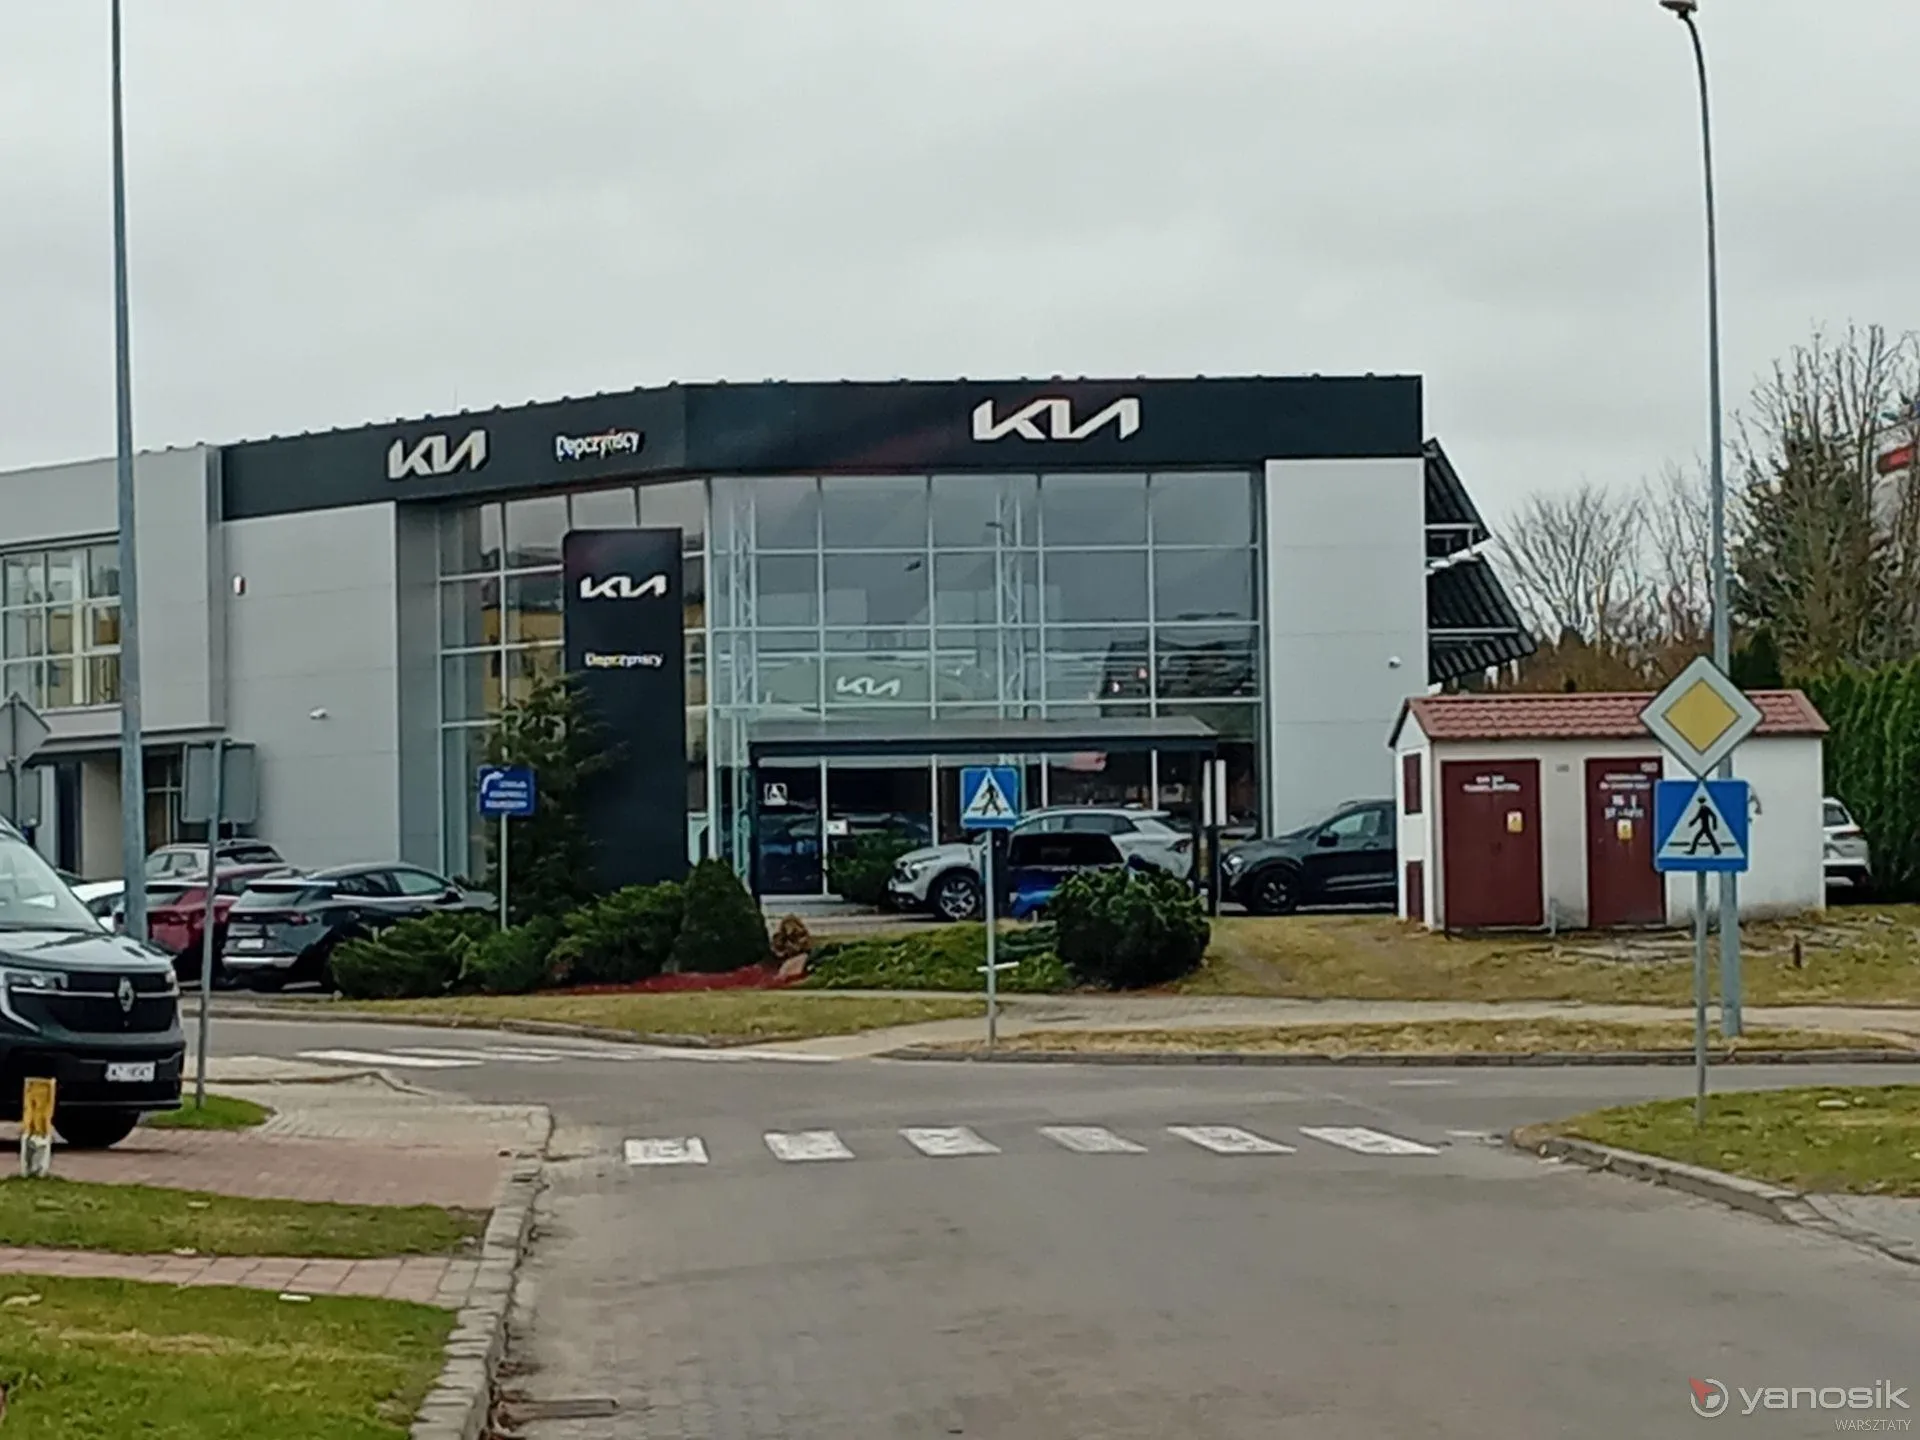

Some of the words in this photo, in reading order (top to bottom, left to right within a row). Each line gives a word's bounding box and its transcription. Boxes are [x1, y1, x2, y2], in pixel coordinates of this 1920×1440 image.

[972, 398, 1139, 440] KIA
[388, 430, 486, 479] KIA
[580, 574, 667, 598] KIA
